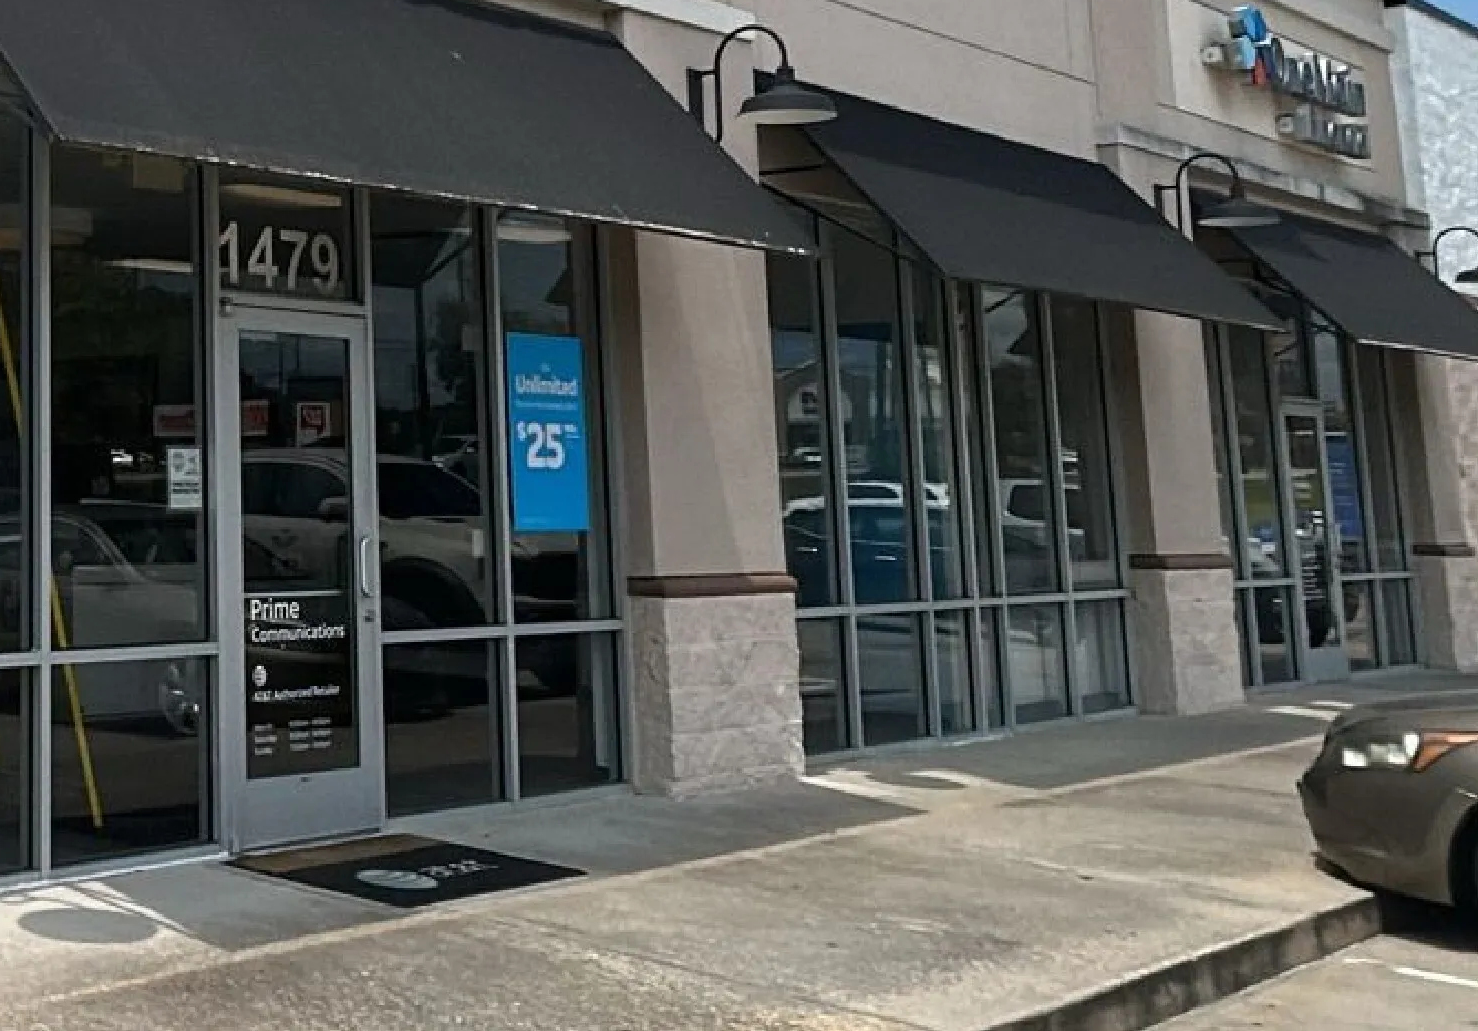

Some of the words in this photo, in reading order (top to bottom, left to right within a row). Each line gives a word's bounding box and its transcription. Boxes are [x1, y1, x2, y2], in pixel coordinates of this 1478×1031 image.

[220, 221, 340, 294] 1479
[515, 373, 579, 397] Unlimited
[250, 598, 300, 621] Prime
[250, 622, 346, 643] Communications
